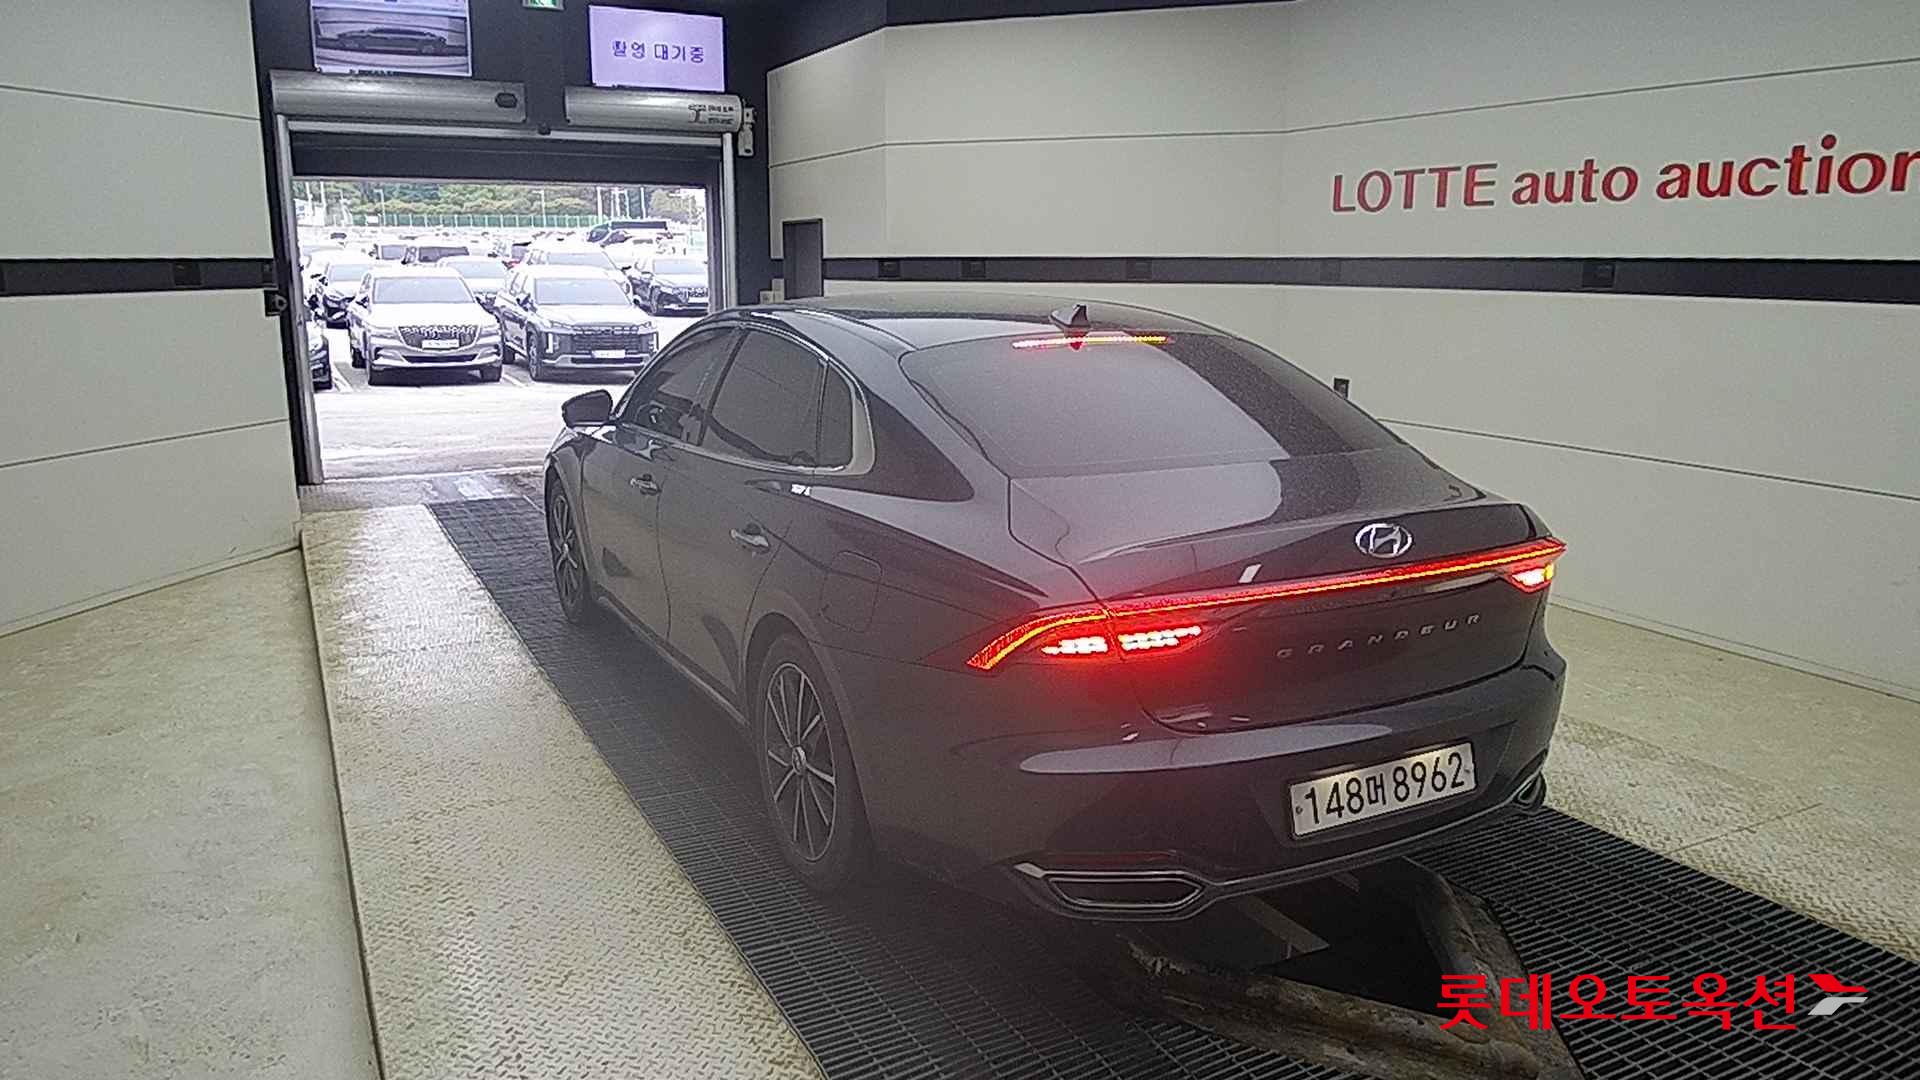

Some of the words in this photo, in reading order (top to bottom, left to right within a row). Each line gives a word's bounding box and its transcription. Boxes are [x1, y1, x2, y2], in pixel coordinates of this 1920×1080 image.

[654, 43, 704, 63] 대기중
[1332, 163, 1498, 212] LOTTE
[1512, 158, 1639, 205] auto
[1276, 614, 1480, 658] GRANDEUR
[1393, 752, 1465, 802] 8962
